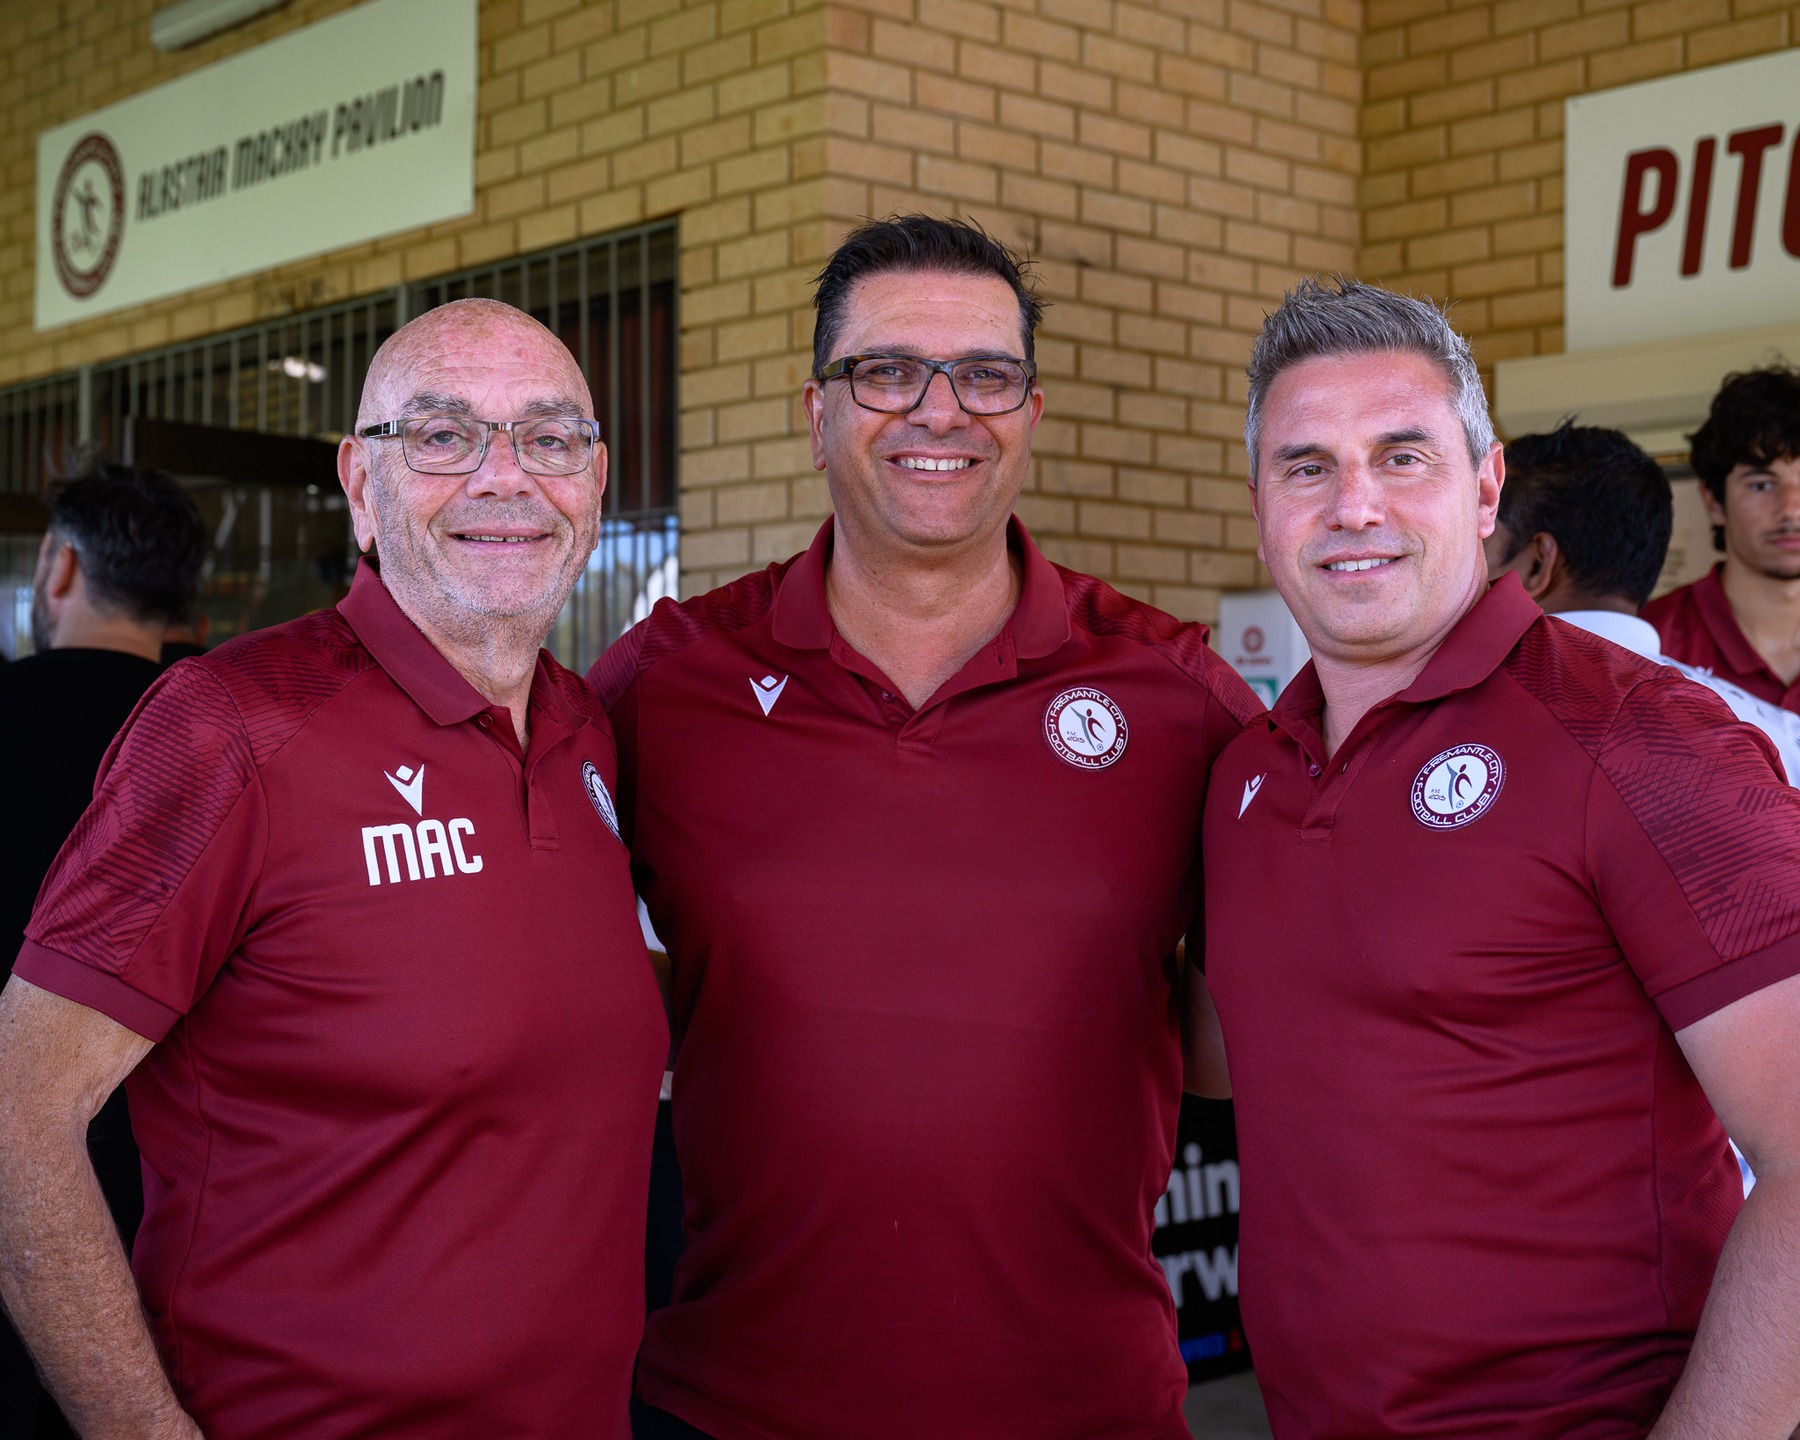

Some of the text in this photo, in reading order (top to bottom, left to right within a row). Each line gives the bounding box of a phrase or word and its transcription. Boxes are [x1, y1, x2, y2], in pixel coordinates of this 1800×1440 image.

[136, 145, 228, 222] ALASTAIR
[232, 108, 328, 191] MACKAY
[331, 68, 444, 159] PAVILION
[1050, 690, 1126, 730] FREMANTLE CITY
[1048, 724, 1124, 766] FOOTBALL CLUB
[1424, 746, 1500, 785] FREMANTLE CITY
[1414, 782, 1490, 825] FOOTBALL CLUB
[361, 818, 484, 886] MAC
